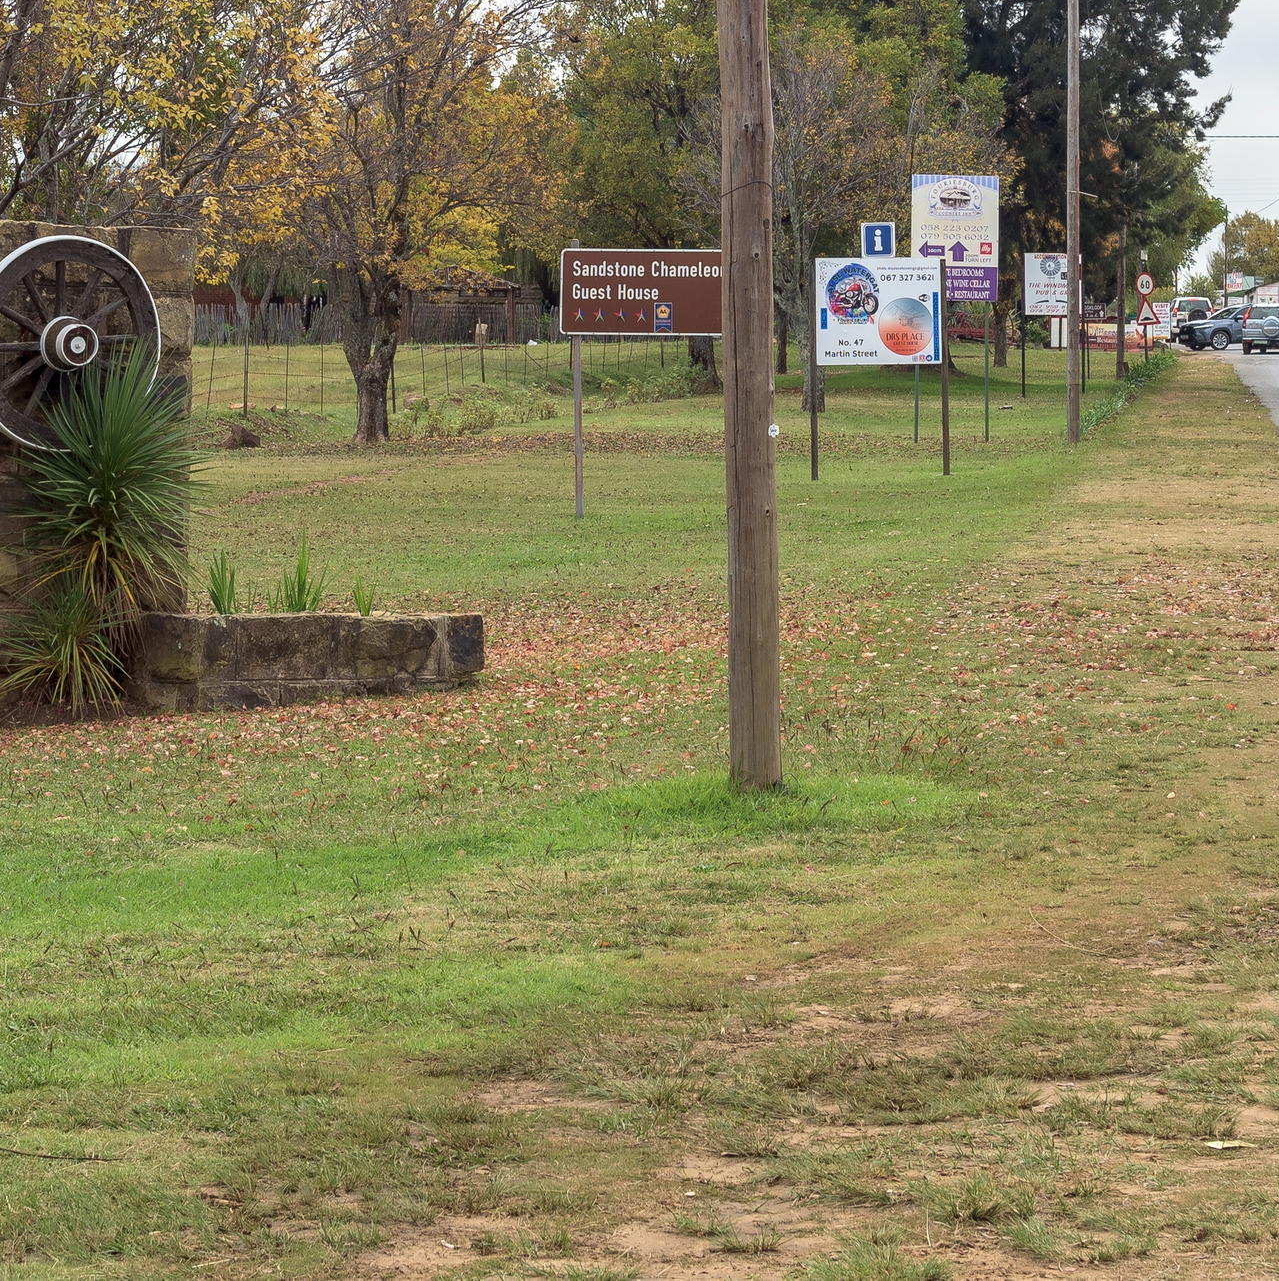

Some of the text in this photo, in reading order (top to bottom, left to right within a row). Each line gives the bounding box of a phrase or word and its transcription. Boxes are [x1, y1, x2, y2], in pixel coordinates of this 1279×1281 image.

[573, 261, 644, 277] Sandstone
[952, 269, 984, 277] BEDROOMS
[970, 280, 990, 288] CELLAR
[1140, 280, 1150, 289] 60
[573, 284, 659, 300] Guest House
[954, 291, 990, 299] RESTAURANT
